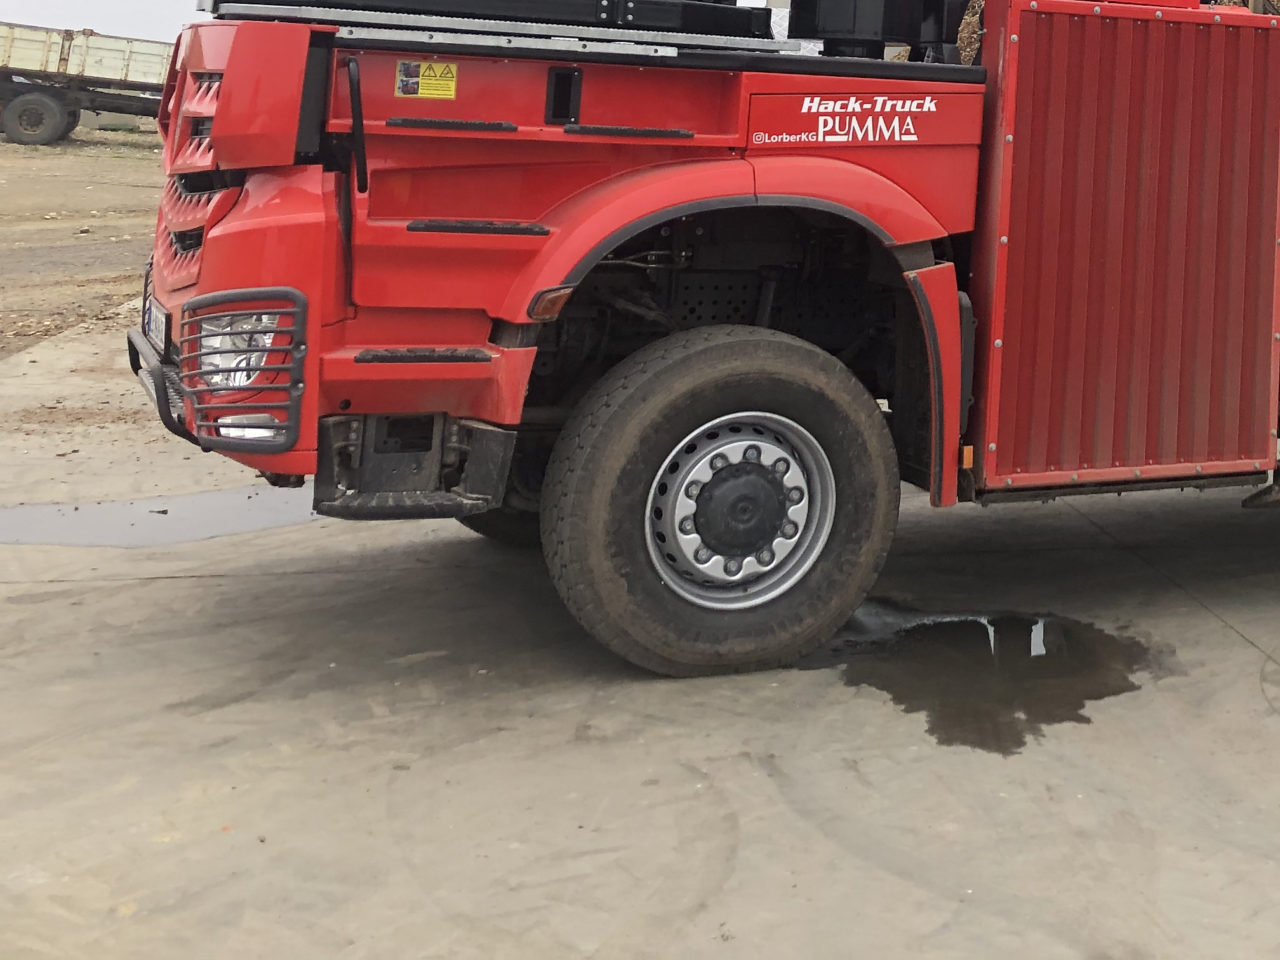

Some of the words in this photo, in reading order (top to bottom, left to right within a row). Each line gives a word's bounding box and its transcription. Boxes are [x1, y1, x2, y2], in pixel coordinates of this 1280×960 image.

[801, 96, 938, 113] Hack-Truck
[817, 115, 919, 142] PUMMA
[764, 132, 817, 143] LorberKG
